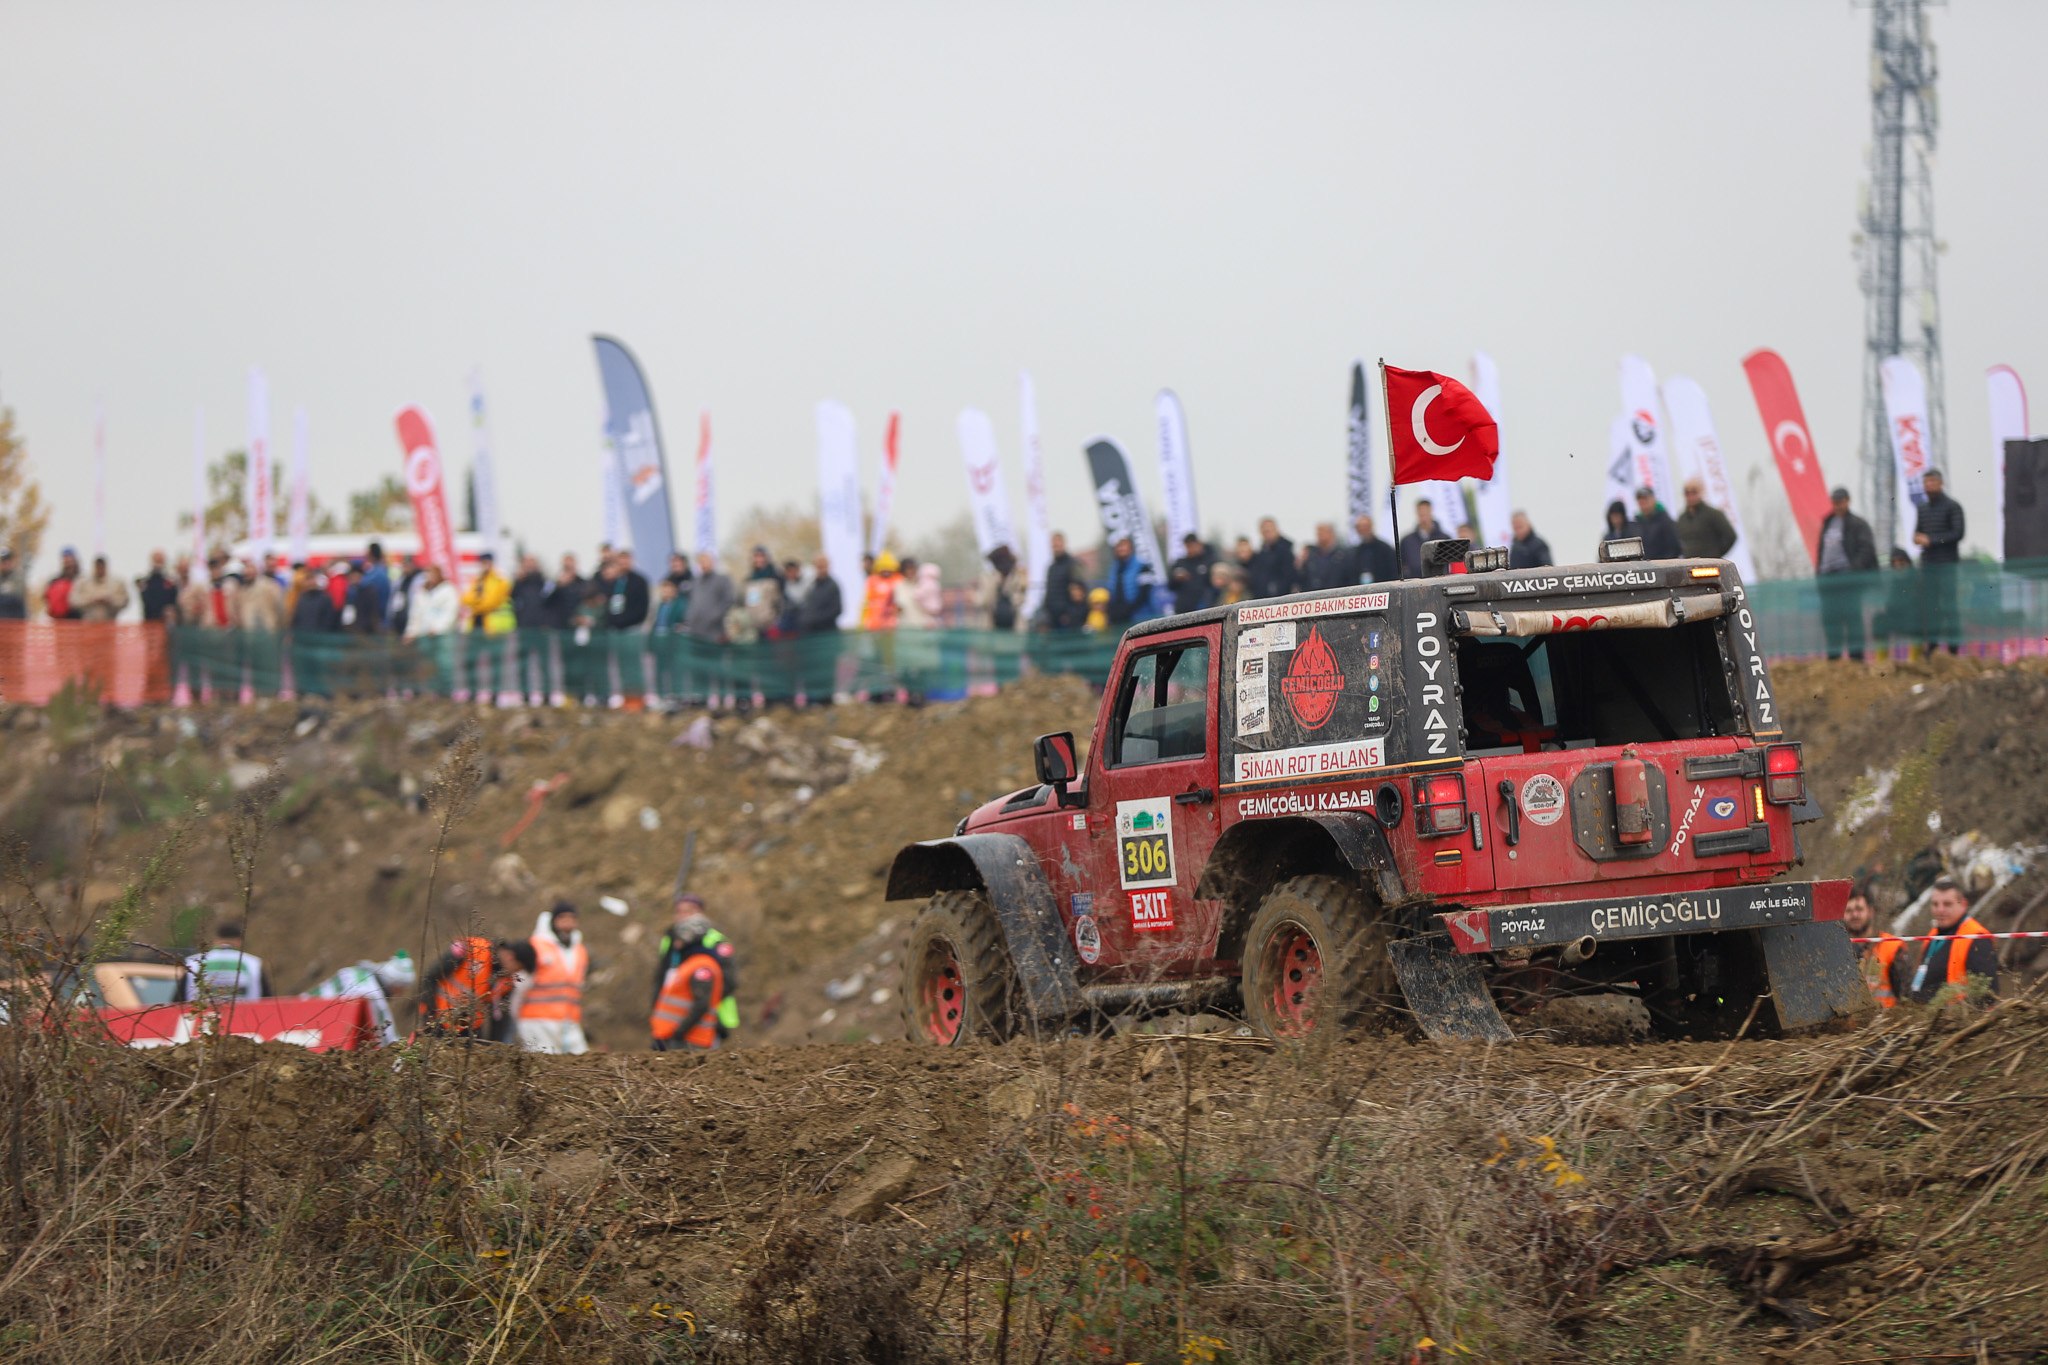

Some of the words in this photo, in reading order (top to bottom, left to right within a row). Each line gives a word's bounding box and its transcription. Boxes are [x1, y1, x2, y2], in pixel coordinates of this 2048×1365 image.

[1501, 578, 1559, 593] YAKUP
[1563, 570, 1657, 592] ÇEMİÇOĞLU
[1240, 608, 1288, 622] SARAÇLAR
[1291, 602, 1312, 616] OTO
[1314, 599, 1345, 613] BAKIM
[1348, 594, 1387, 610] SERVİSİ
[1733, 585, 1773, 723] POYRAZ
[1281, 669, 1345, 698] ÇEMİÇOĞLU
[1416, 612, 1449, 754] POYRAZ
[1241, 756, 1284, 779] SİNAN
[1288, 754, 1317, 774] ROT
[1320, 747, 1379, 771] BALANS
[1238, 791, 1315, 820] ÇEMİÇOĞLU
[1318, 789, 1374, 810] KASABI
[1670, 784, 1705, 857] POYRAZ
[1125, 838, 1167, 876] 306
[1131, 892, 1168, 920] EXIT
[1501, 918, 1546, 933] POYRAZ
[1591, 896, 1722, 935] ÇEMİÇOĞLU
[1749, 900, 1767, 911] AŞK
[1768, 897, 1780, 908] İLE
